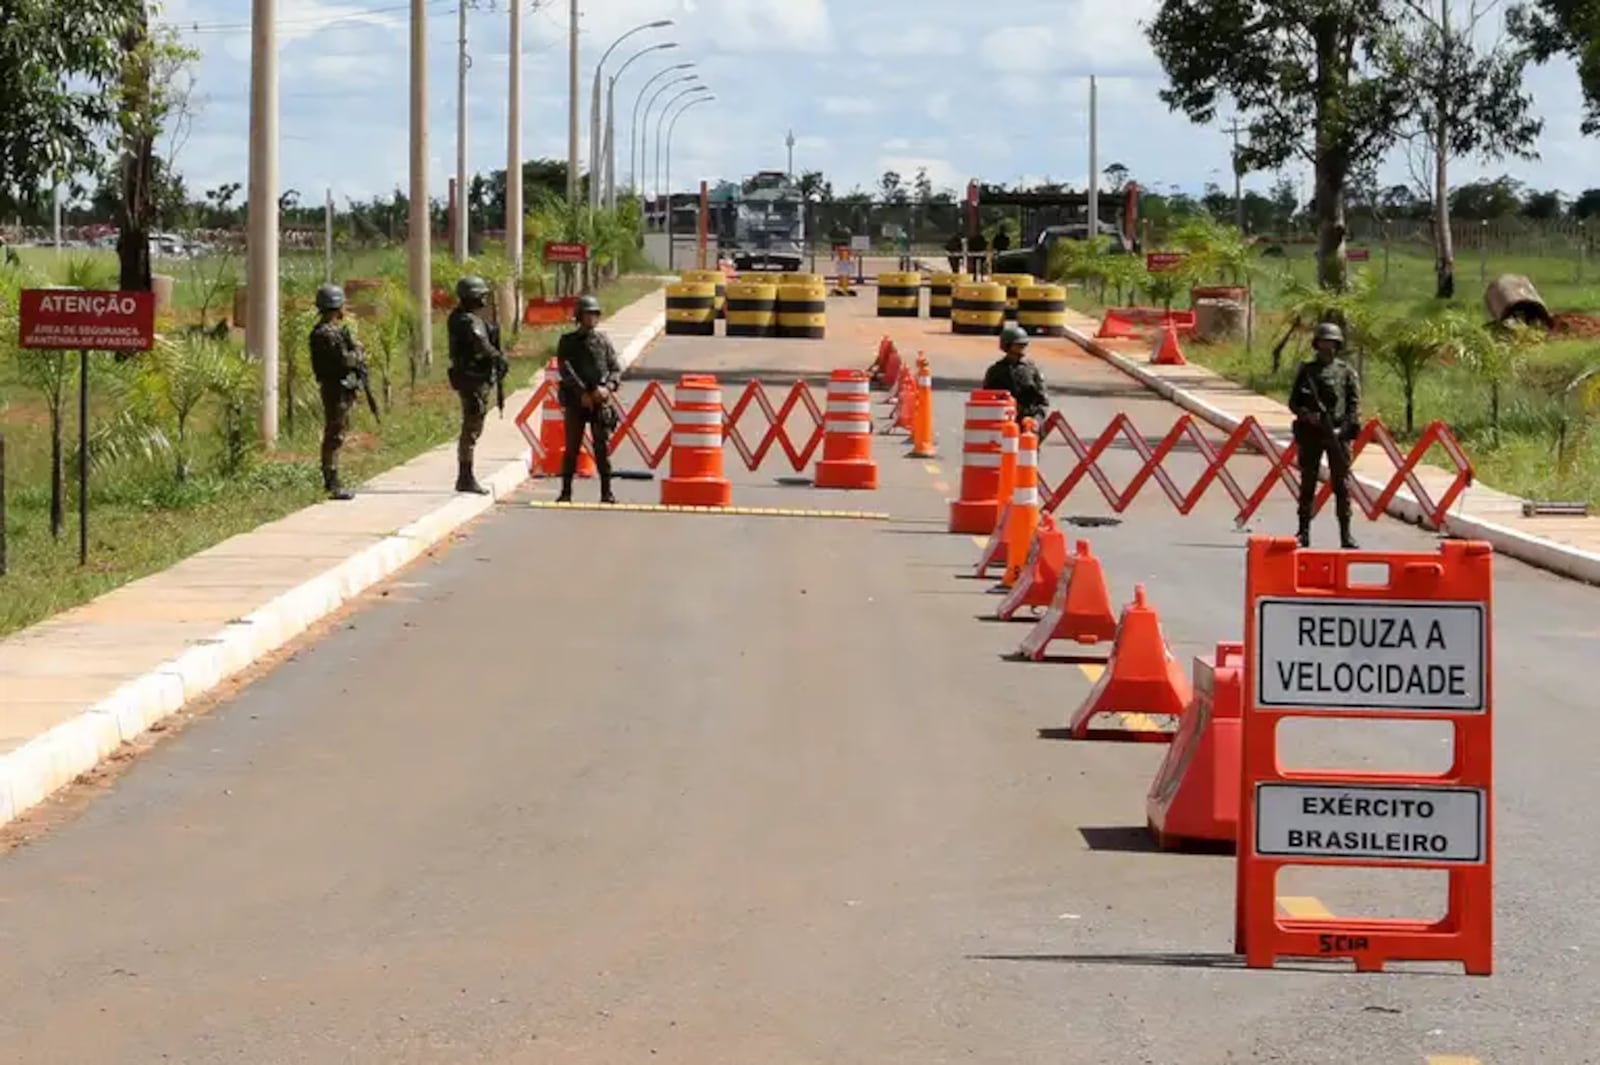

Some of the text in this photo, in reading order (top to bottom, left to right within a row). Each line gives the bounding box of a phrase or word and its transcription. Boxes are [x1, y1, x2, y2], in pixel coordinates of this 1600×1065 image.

[39, 294, 136, 316] ATENÇÃO
[1298, 617, 1447, 649] REDUZA A
[1277, 661, 1466, 695] VELOCIDADE
[1302, 793, 1435, 818] EXÉRCITO
[1287, 830, 1448, 853] BRASILEIRO
